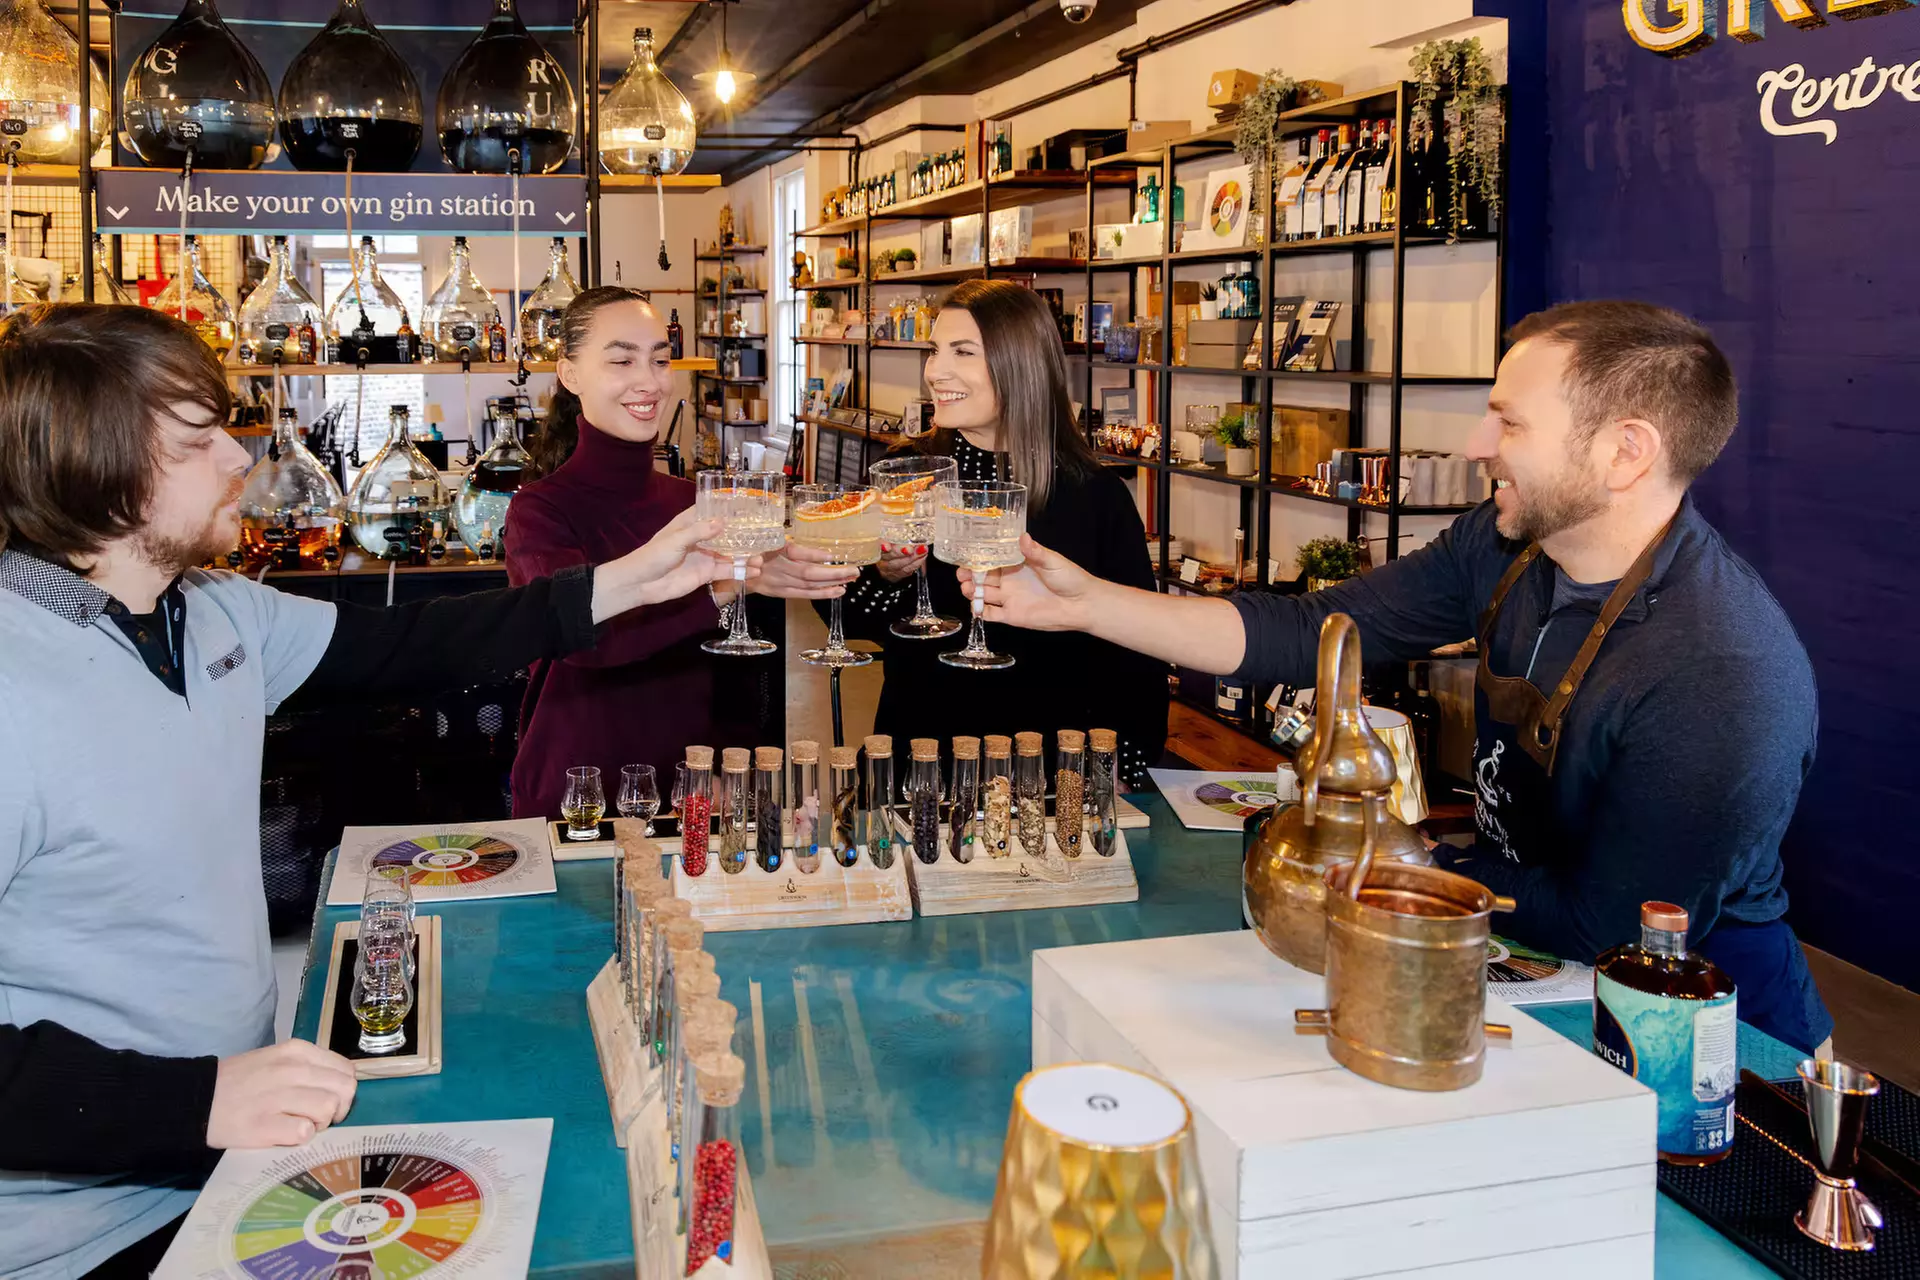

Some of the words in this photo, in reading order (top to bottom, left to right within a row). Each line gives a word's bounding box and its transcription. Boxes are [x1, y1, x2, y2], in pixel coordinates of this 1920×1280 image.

[1756, 56, 1920, 146] Centre
[155, 185, 239, 213] Make
[245, 194, 314, 220] your
[321, 196, 382, 215] own
[389, 191, 433, 222] gin
[440, 193, 536, 217] station
